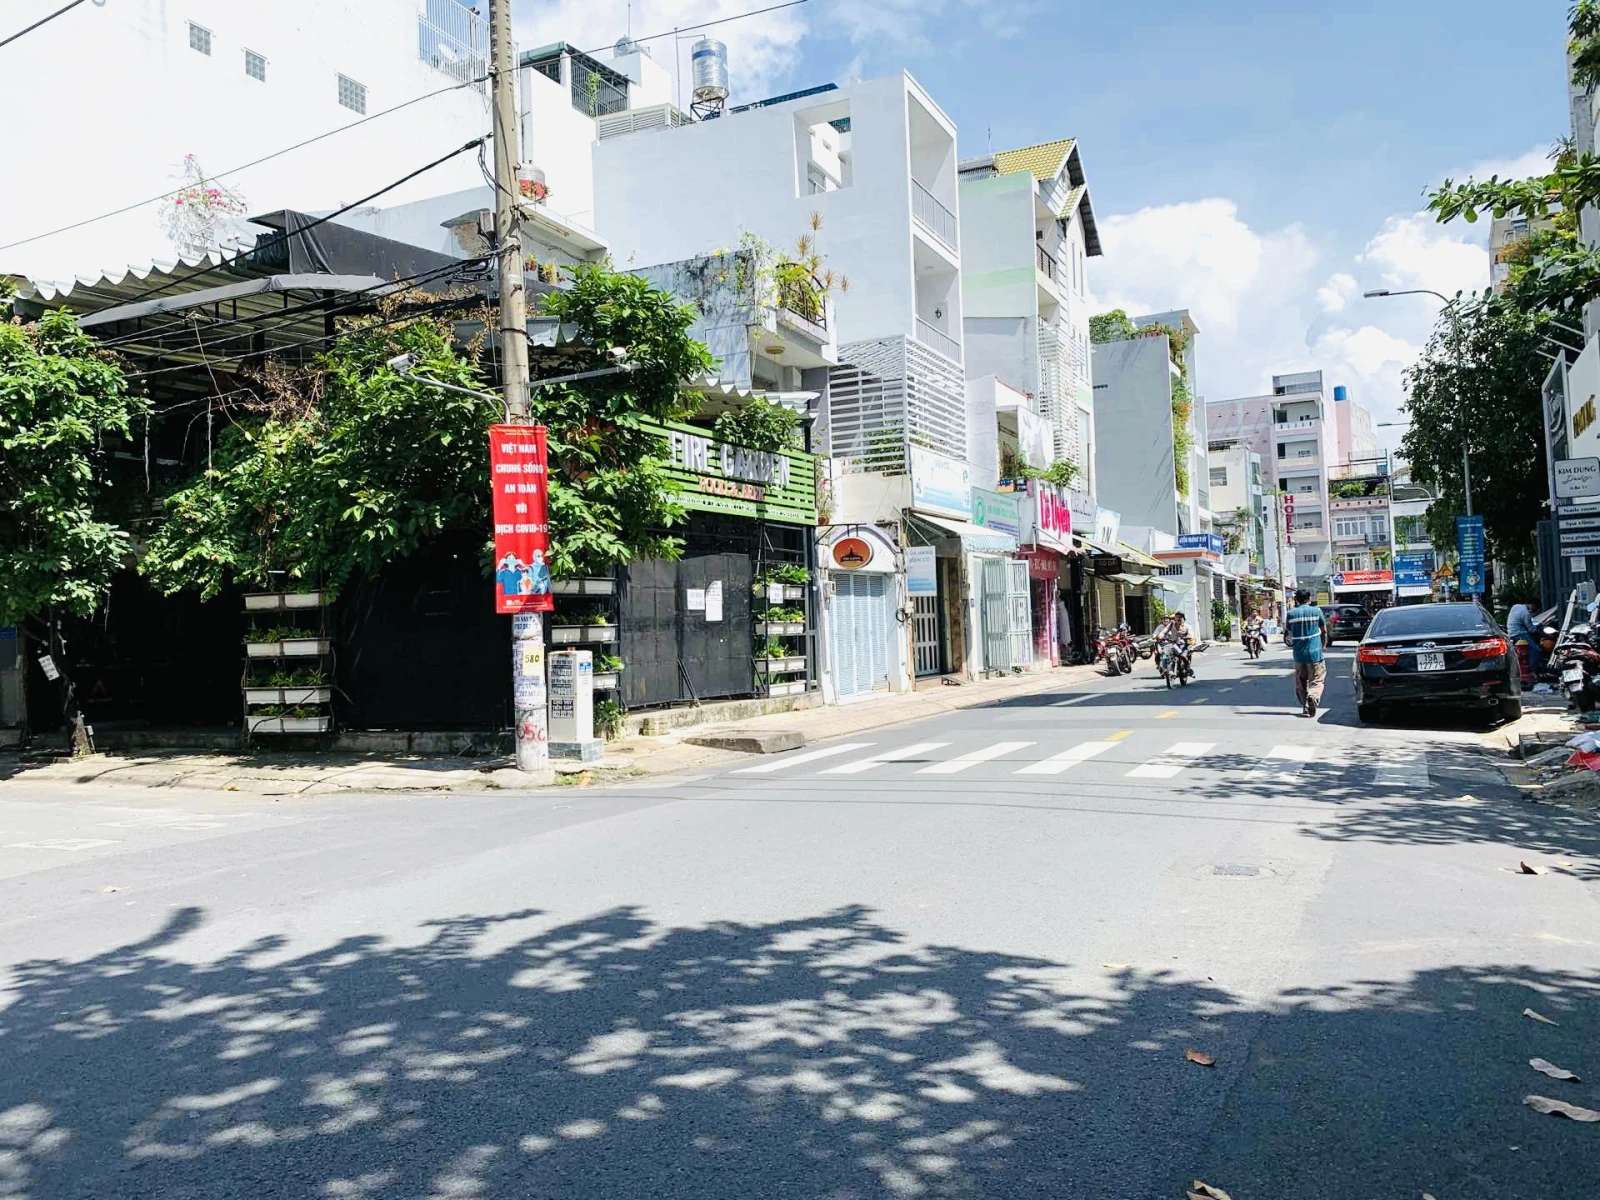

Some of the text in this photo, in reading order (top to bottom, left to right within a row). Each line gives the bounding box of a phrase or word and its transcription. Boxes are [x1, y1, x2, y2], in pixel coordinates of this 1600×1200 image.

[501, 442, 537, 455] VIỆT NAM
[668, 430, 715, 473] FIRE
[495, 461, 544, 474] CHUNG SỐNG
[1573, 465, 1596, 473] DUNG
[504, 482, 537, 493] AN TOÀN
[1283, 495, 1295, 546] HOTEL
[495, 523, 548, 535] DỊCH COVID-19
[524, 654, 540, 663] 580
[1424, 653, 1438, 661] 15A
